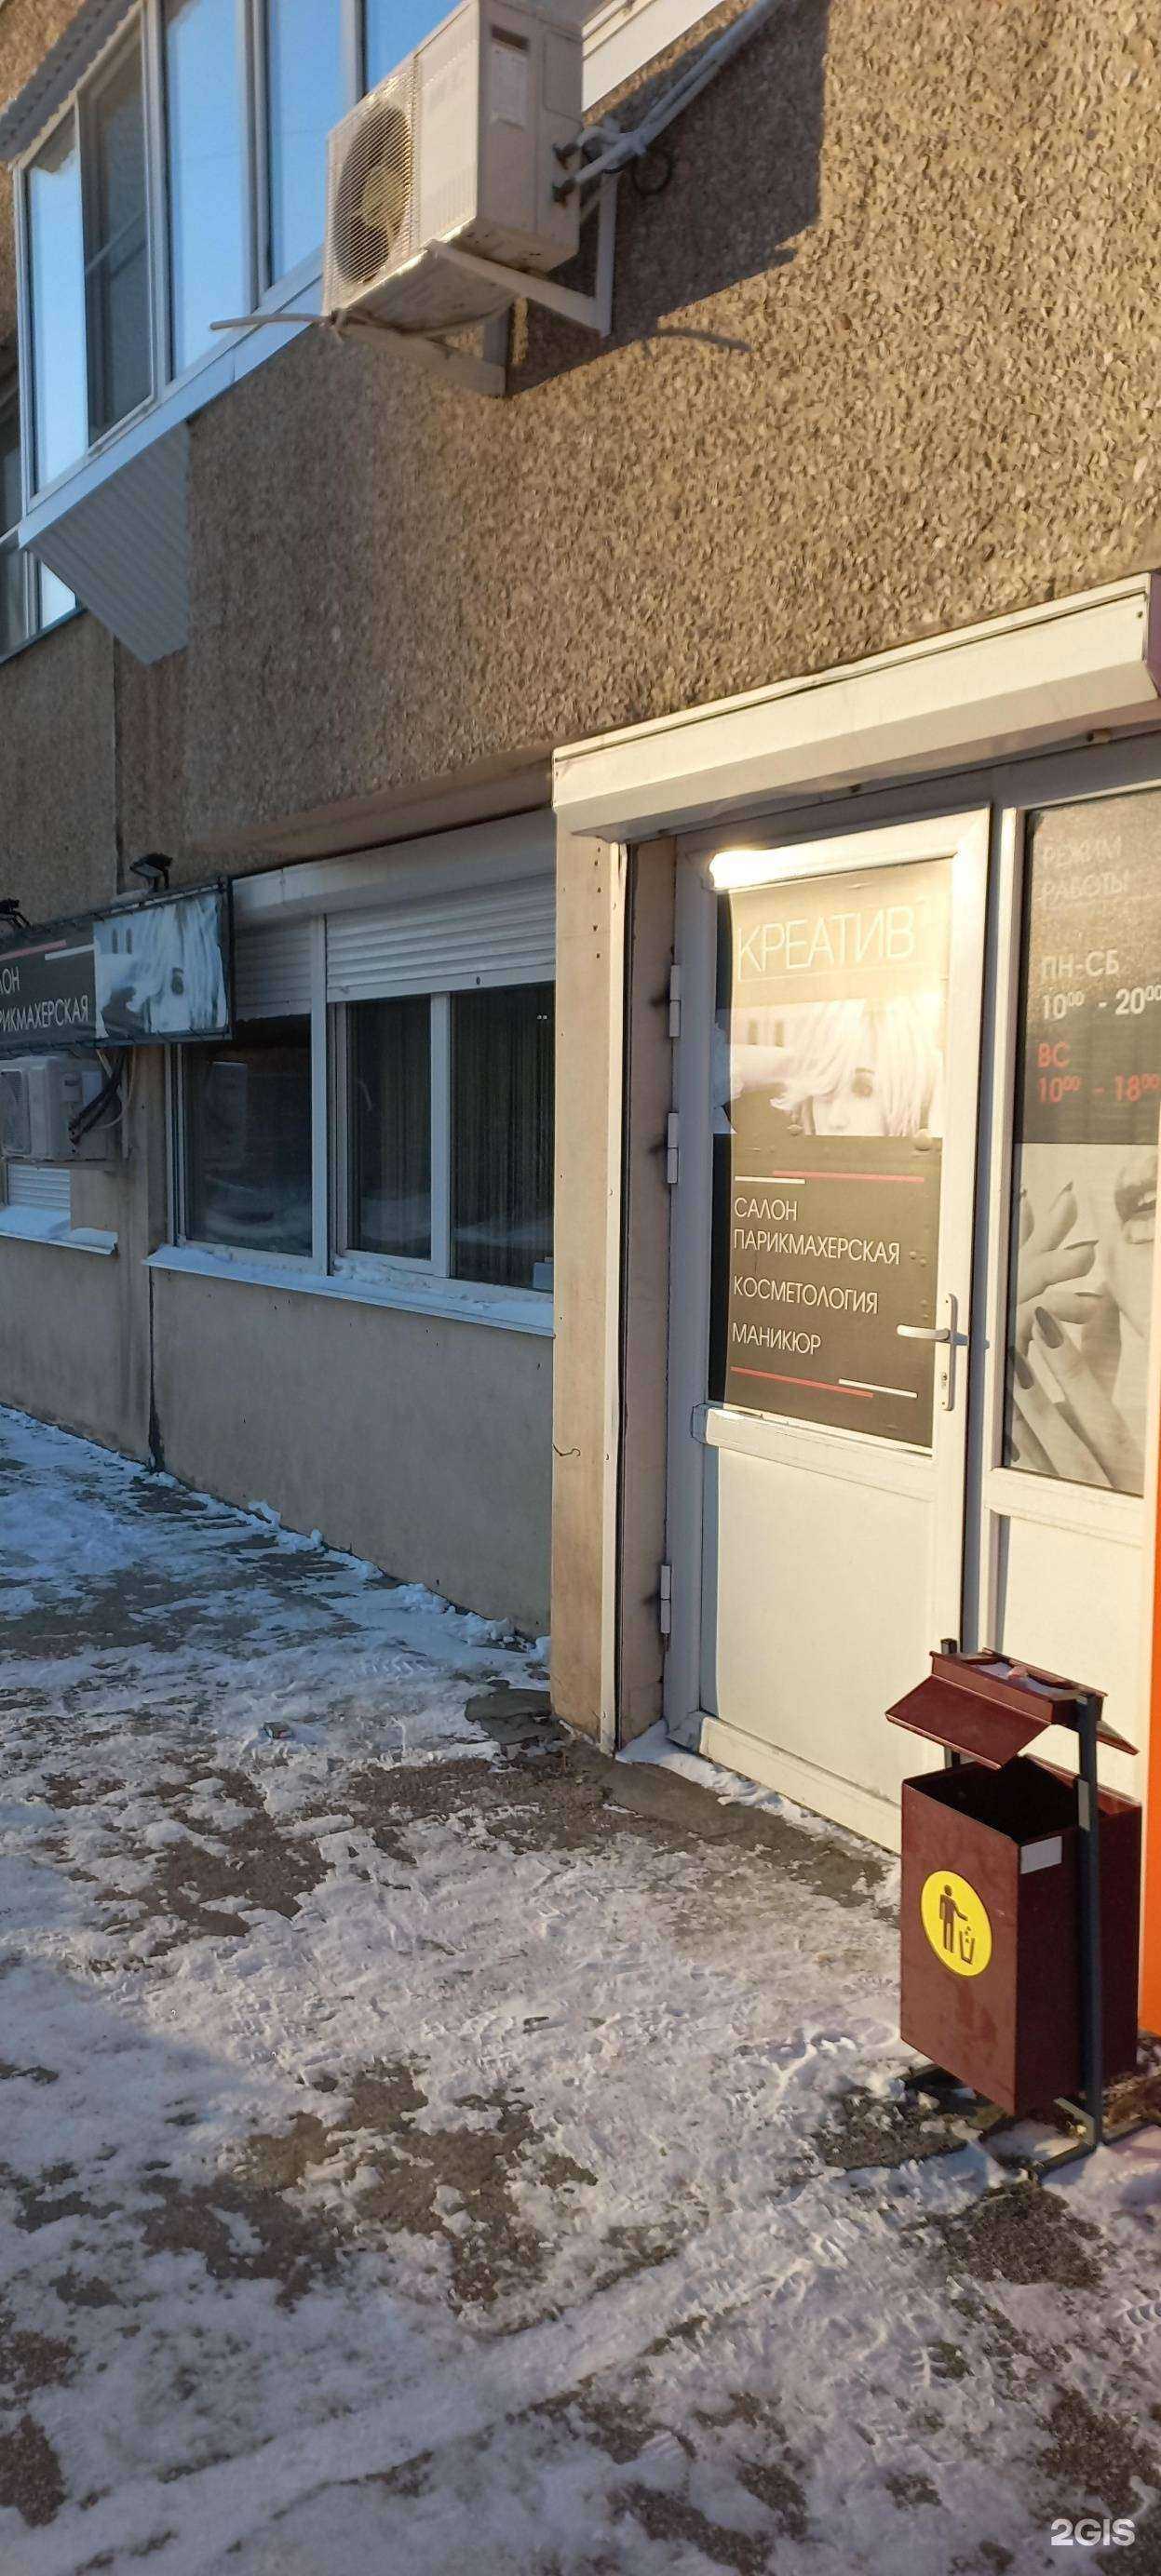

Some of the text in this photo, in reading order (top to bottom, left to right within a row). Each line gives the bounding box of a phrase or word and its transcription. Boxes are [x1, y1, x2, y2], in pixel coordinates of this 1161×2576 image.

[736, 906, 915, 983] КРЕАТИВ
[0, 966, 20, 995] ОН
[1041, 948, 1120, 981] ПН-СБ
[1037, 1040, 1071, 1068] ВС
[734, 1197, 798, 1222] САЛОН
[733, 1228, 901, 1267] ПАРИКМАХЕРСКАЯ
[733, 1275, 880, 1315] КОСМЕТОЛОГИЯ
[732, 1322, 822, 1355] МАНИКЮР
